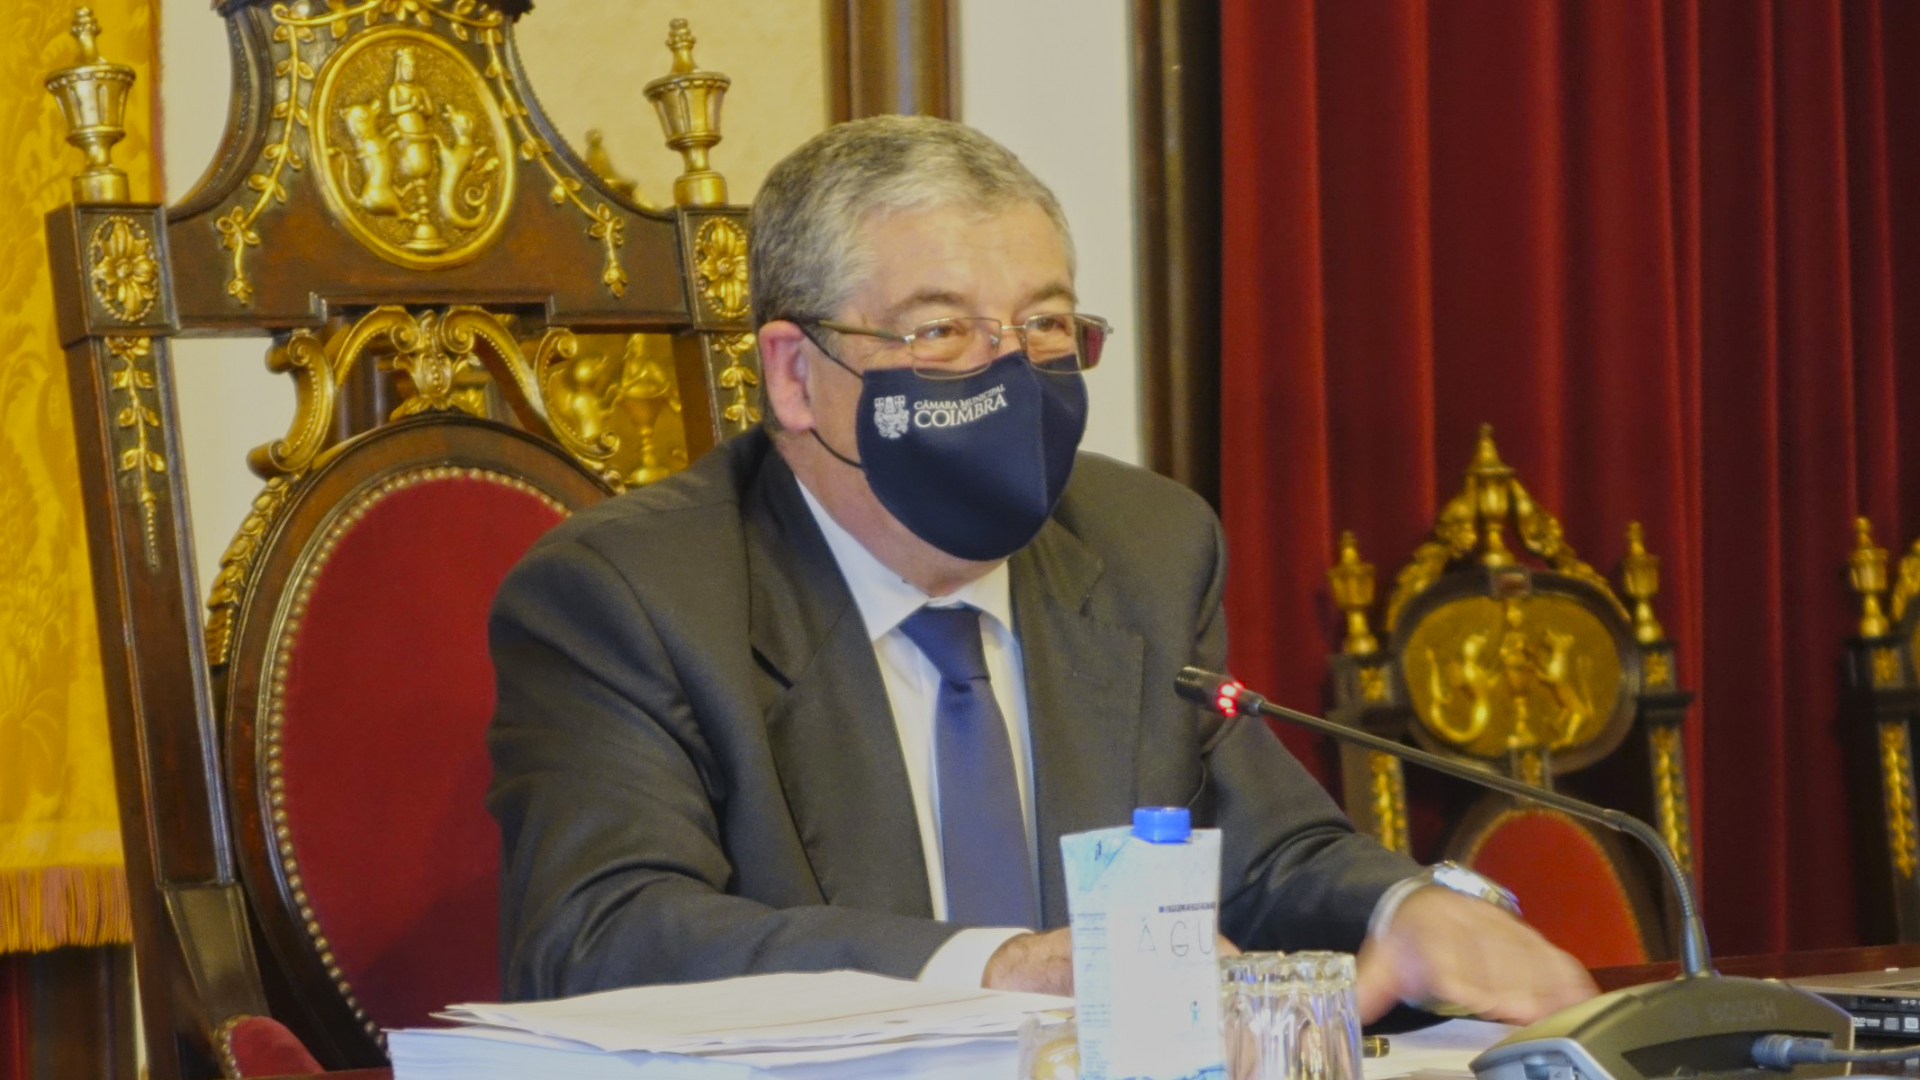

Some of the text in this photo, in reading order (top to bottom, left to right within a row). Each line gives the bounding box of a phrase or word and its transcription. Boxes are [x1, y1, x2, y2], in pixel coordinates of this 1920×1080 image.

[914, 383, 1006, 411] CÂMARA MUNICIPAL
[914, 393, 1008, 428] COIMBRA
[1707, 1000, 1779, 1022] BOSCH
